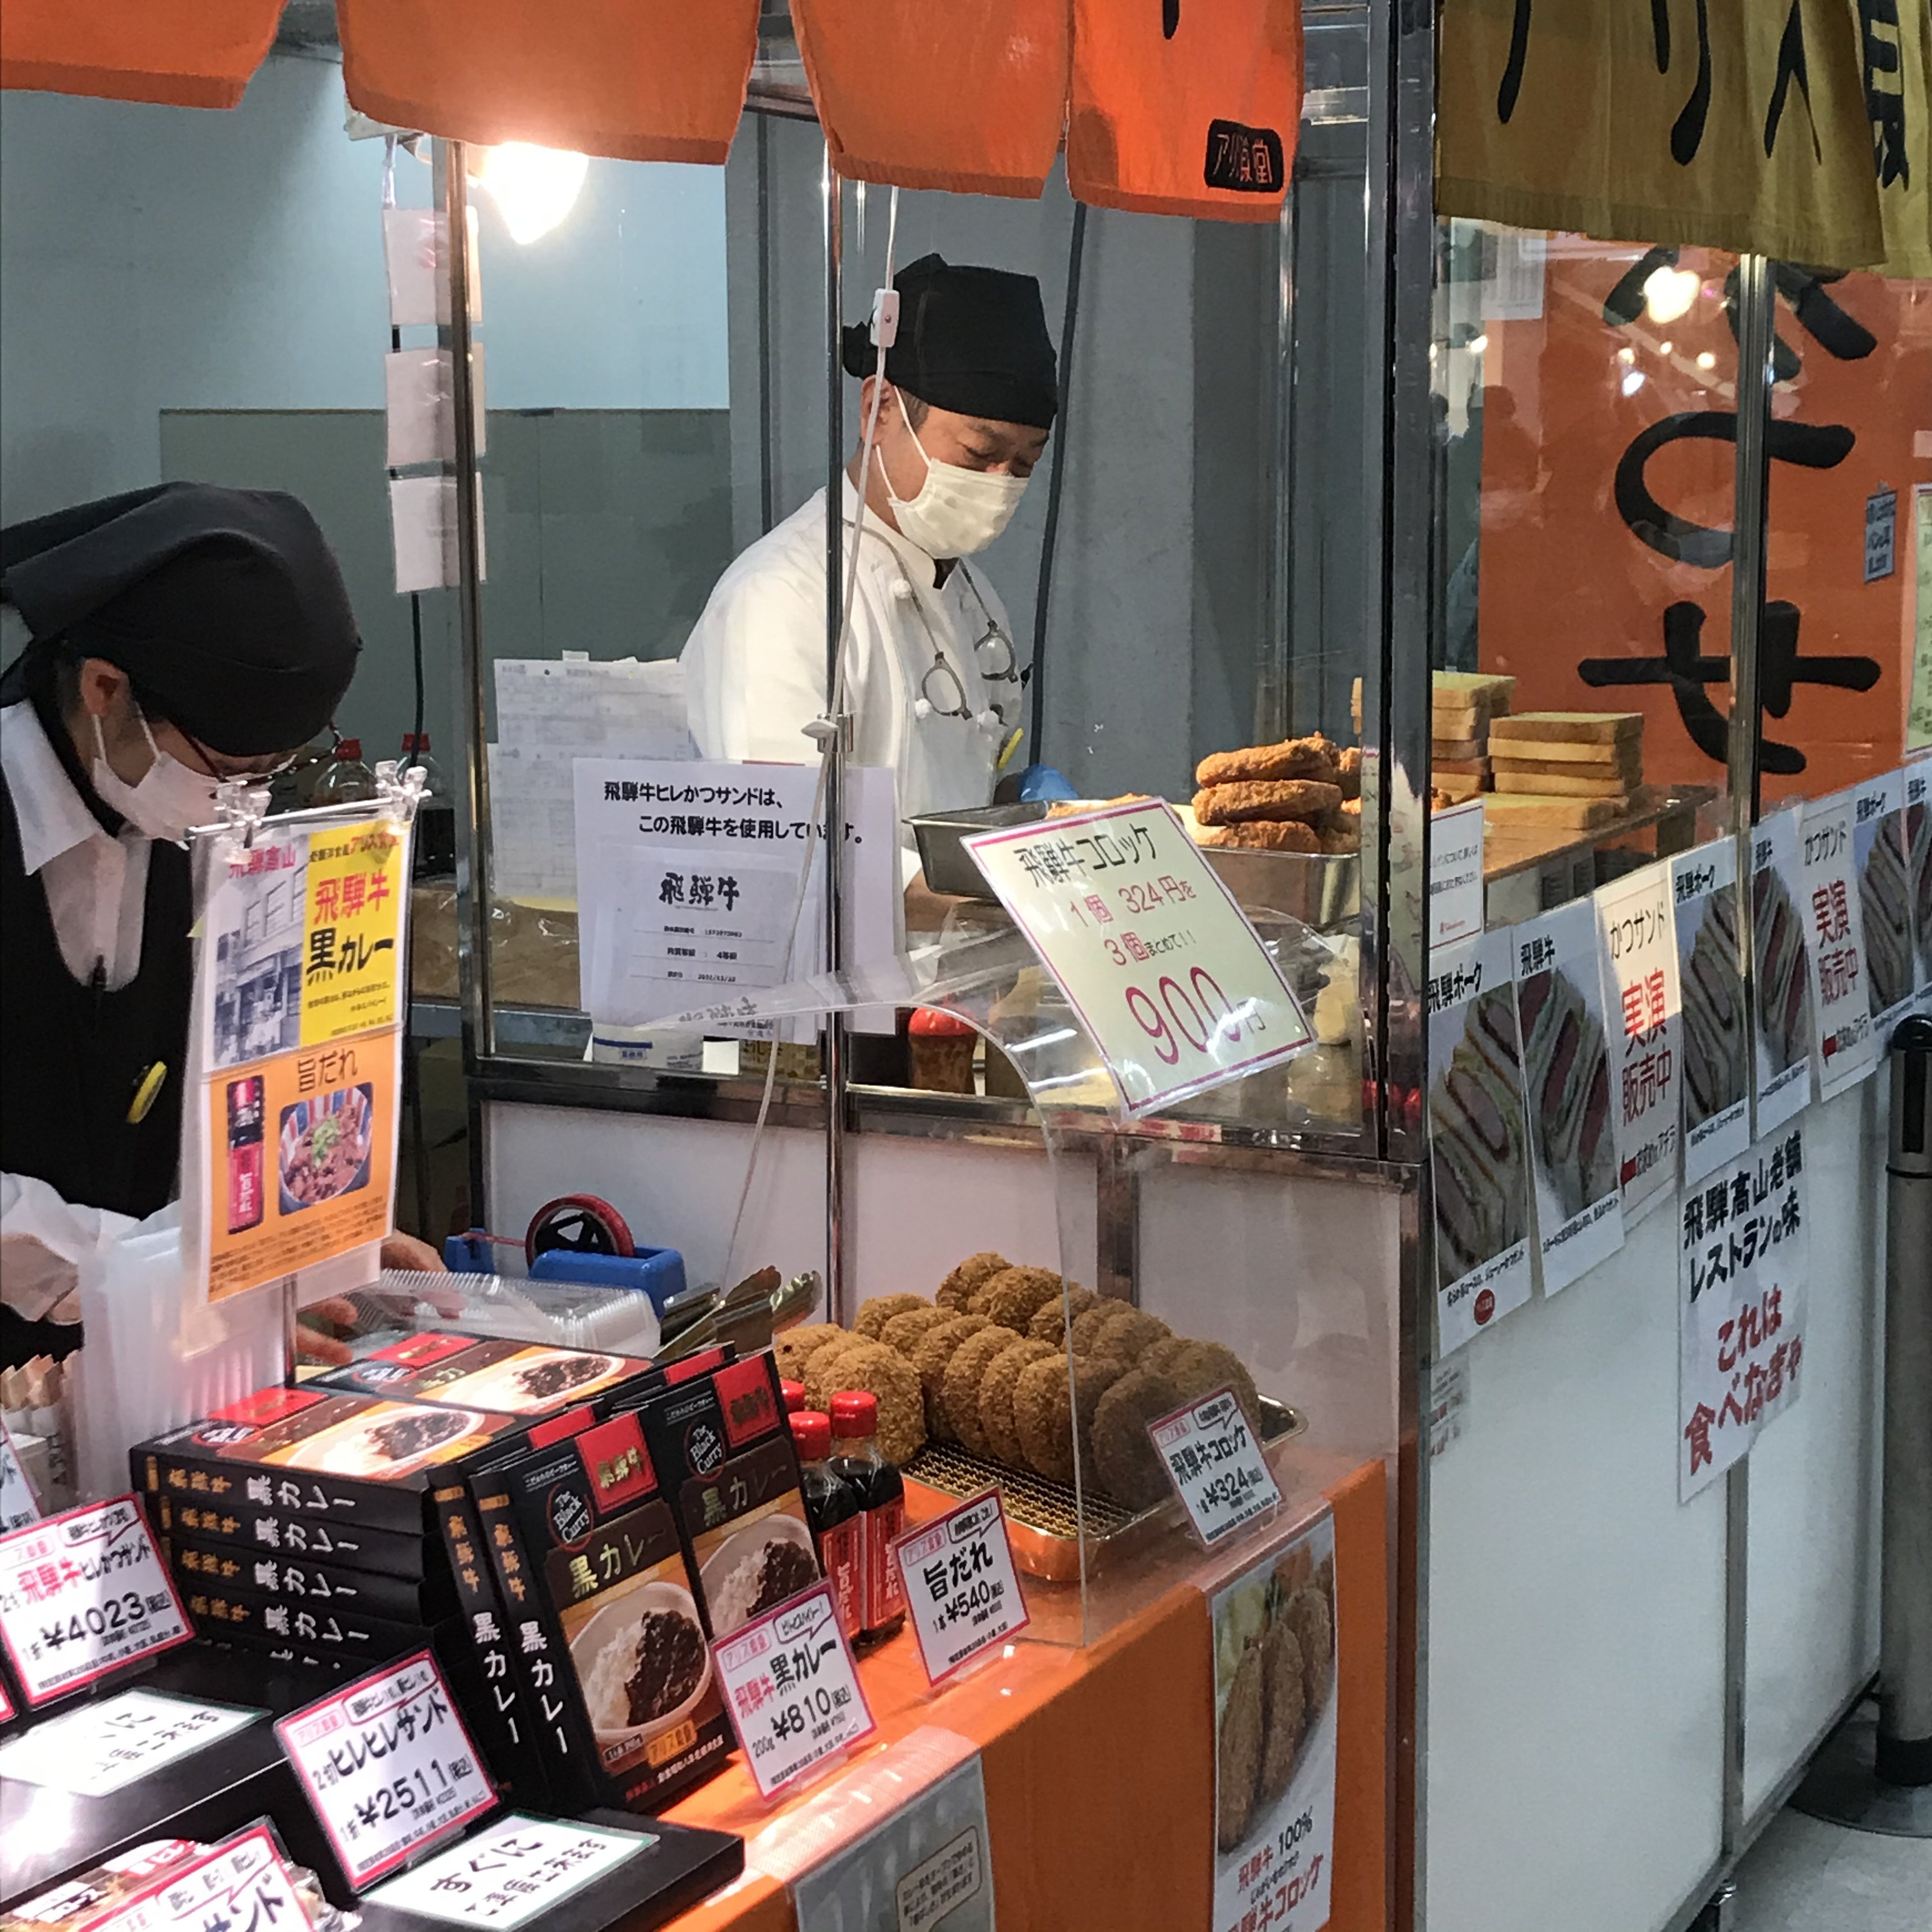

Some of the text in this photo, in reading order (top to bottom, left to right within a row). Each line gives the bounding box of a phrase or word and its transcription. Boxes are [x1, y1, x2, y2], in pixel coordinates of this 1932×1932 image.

[604, 781, 784, 808] 飛騨牛ヒレかつサンドは、
[639, 816, 862, 844] この飛騨牛を使用していす。
[1014, 822, 1158, 888] 飛騨牛コロッケ
[314, 869, 390, 924] 飛騨牛
[659, 872, 740, 912] 飛騨牛
[1070, 894, 1114, 928] 1個
[306, 927, 394, 986] 黒カレー
[1520, 934, 1556, 976] 飛騨牛
[1610, 902, 1665, 960] かつサンド
[1125, 966, 1266, 1065] 900円
[1621, 967, 1667, 1057] 実演
[299, 1049, 359, 1092] 旨だれ
[1622, 1044, 1672, 1127] 販売中
[1684, 1129, 1803, 1250] 飛騨高山老舗
[1690, 1186, 1800, 1303] レストランの味
[1718, 1283, 1782, 1372] これは
[690, 1430, 716, 1461] Black
[697, 1443, 723, 1474] Curry
[1169, 1424, 1246, 1486] 飛騨牛コロッケ
[247, 1474, 356, 1508] 黒カレー
[554, 1495, 582, 1531] Black
[555, 1491, 571, 1508] The
[702, 1465, 787, 1527] 黒カレー
[1203, 1466, 1249, 1507] ¥324
[255, 1516, 359, 1552] 黒カレー
[562, 1510, 590, 1544] Curry
[254, 1560, 357, 1598] 黒カレー
[568, 1529, 666, 1599] 黒カレー
[924, 1541, 993, 1602] 旨だれ
[40, 1591, 145, 1650] ¥4023
[265, 1604, 370, 1642] 黒カレー
[945, 1580, 990, 1623] ¥540
[473, 1611, 520, 1744] 黒カレー
[519, 1621, 568, 1754] 黒カレー
[328, 1687, 448, 1776] ヒレヒレサンド
[771, 1688, 831, 1741] ¥810
[354, 1758, 448, 1828] ¥2511
[1279, 1805, 1313, 1855] 100%
[1228, 1853, 1323, 1932] 騨牛コロッケ
